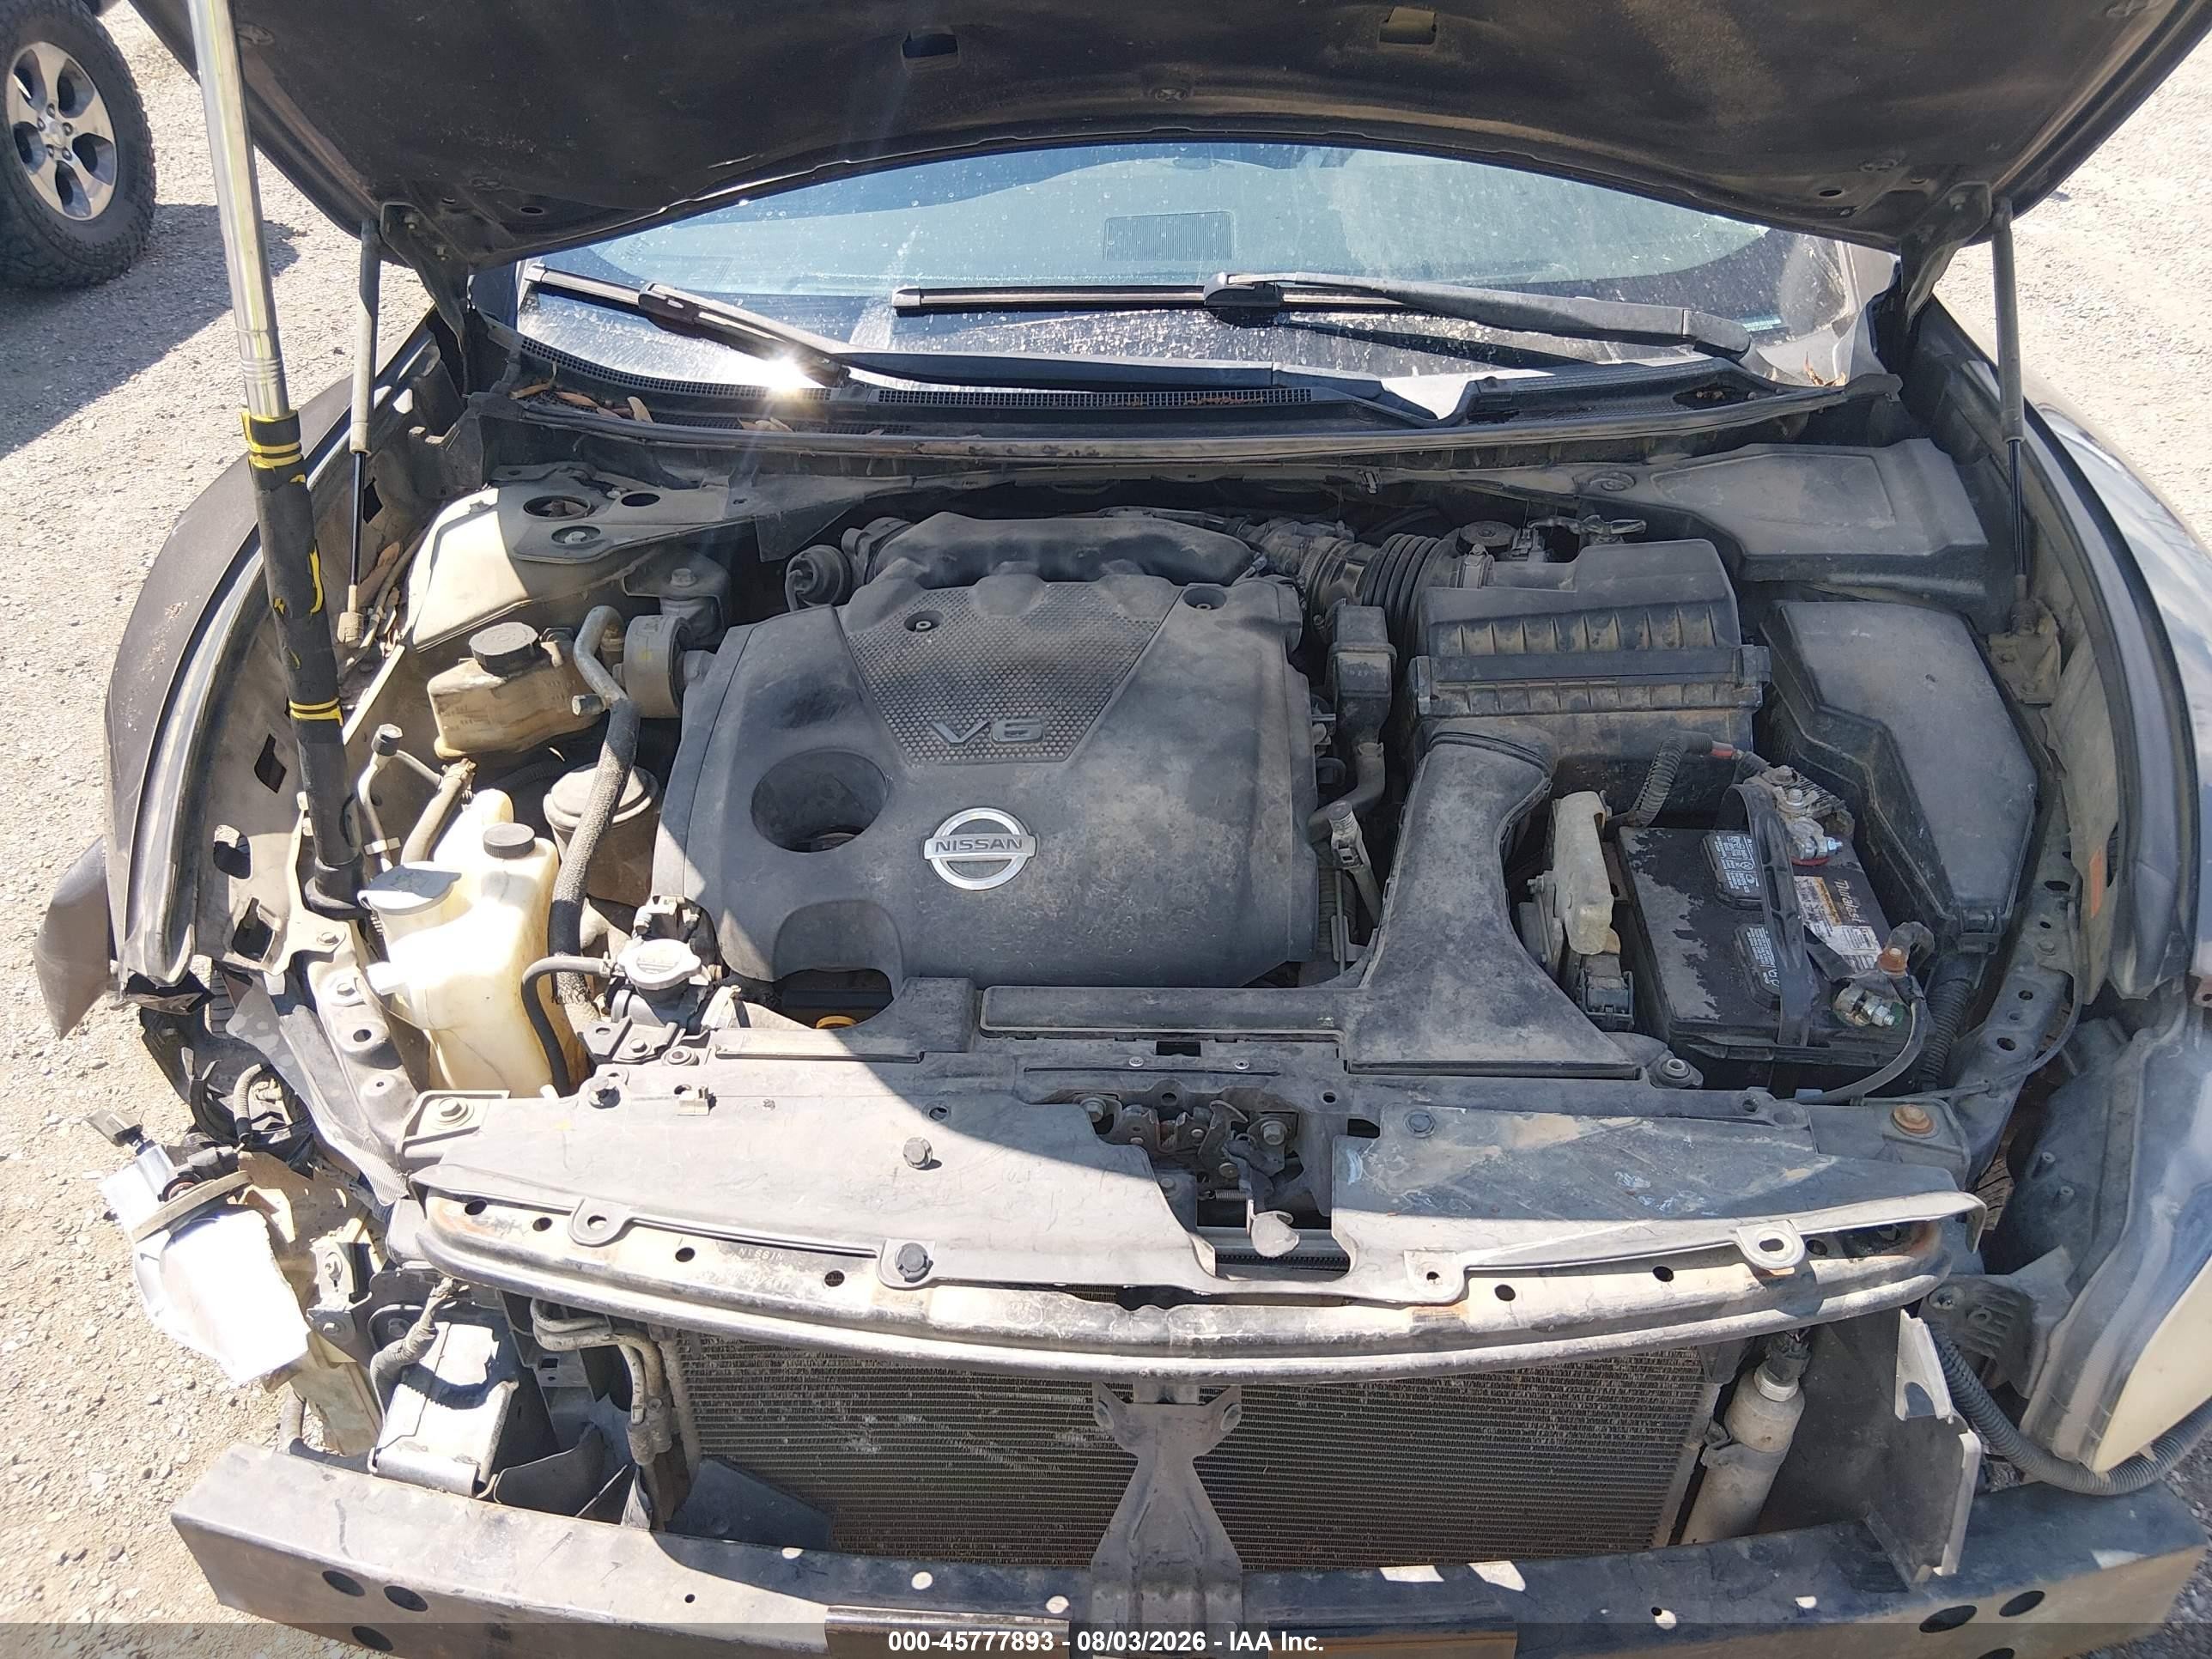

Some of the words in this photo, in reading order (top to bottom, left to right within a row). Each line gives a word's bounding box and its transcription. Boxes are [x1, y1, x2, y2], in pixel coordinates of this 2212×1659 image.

[929, 720, 1043, 744] V6
[934, 838, 1024, 854] NISSAN
[1834, 878, 1867, 925] Duralast
